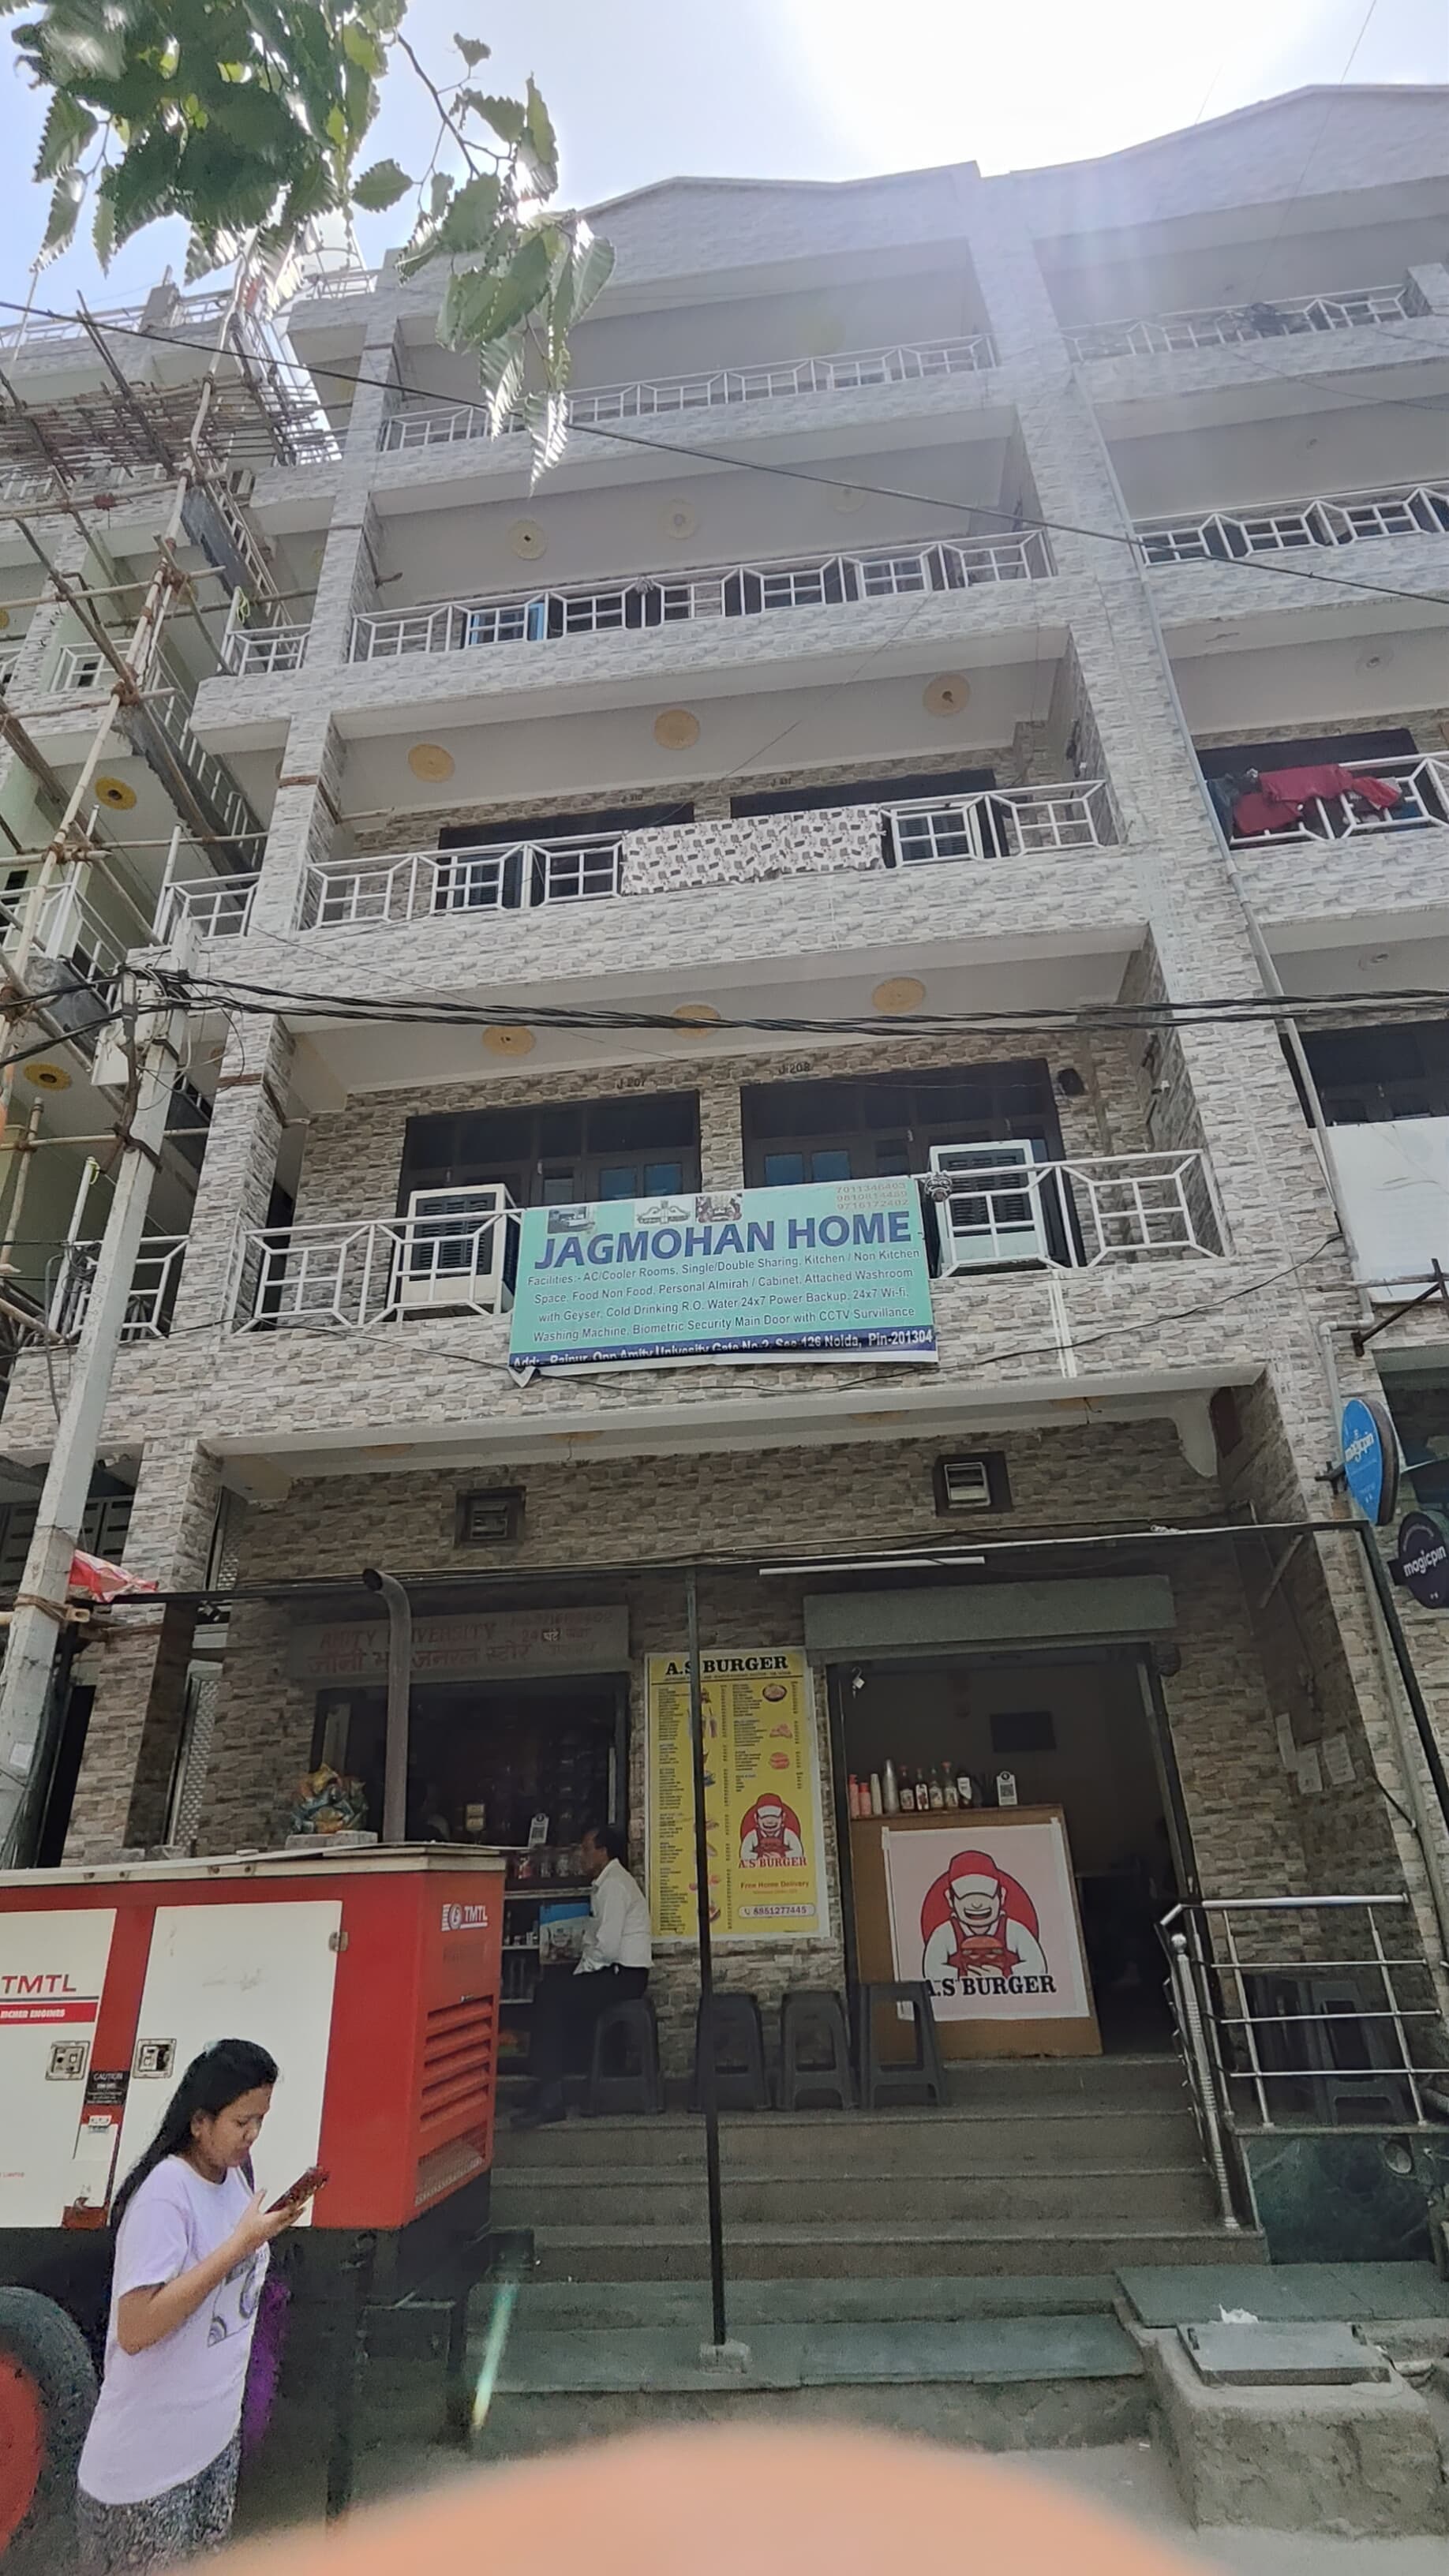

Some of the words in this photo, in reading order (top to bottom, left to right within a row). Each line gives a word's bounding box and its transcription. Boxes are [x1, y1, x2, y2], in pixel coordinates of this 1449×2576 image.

[534, 1221, 774, 1270] JAGMOHAN
[788, 1211, 911, 1249] HOME
[583, 1268, 636, 1282] AC/Cooler
[682, 1259, 754, 1275] Single/Double
[805, 1253, 844, 1264] Kitchen
[854, 1252, 875, 1261] Non
[879, 1249, 919, 1260] Kitchen
[573, 1290, 598, 1301] Food
[602, 1290, 623, 1299] Non
[659, 1282, 705, 1294] Personal
[708, 1279, 748, 1290] Almirah
[805, 1271, 852, 1283] Attached
[855, 1269, 913, 1280] Washroom
[539, 1312, 560, 1322] with
[606, 1306, 631, 1317] Cold
[634, 1304, 678, 1315] Drinking
[708, 1299, 738, 1309] Water
[741, 1296, 766, 1307] 24x7
[769, 1294, 803, 1305] Power
[853, 1289, 878, 1300] 24x7
[534, 1330, 578, 1342] Washing
[633, 1321, 684, 1335] Biometric
[687, 1318, 732, 1331] Security
[735, 1316, 760, 1327] Main
[764, 1314, 790, 1325] Door
[793, 1312, 815, 1323] with
[819, 1309, 850, 1321] CCTV
[854, 1308, 915, 1320] Survillance
[868, 1329, 932, 1346] Pin-201304
[1402, 1545, 1447, 1577] magicpin
[703, 1656, 788, 1673] BURGER
[759, 1856, 807, 1867] BURGER
[464, 1905, 488, 1923] TMTL
[2, 1974, 77, 1994] TMTL
[962, 1975, 1057, 1996] BURGER
[94, 2072, 123, 2081] CAUTION
